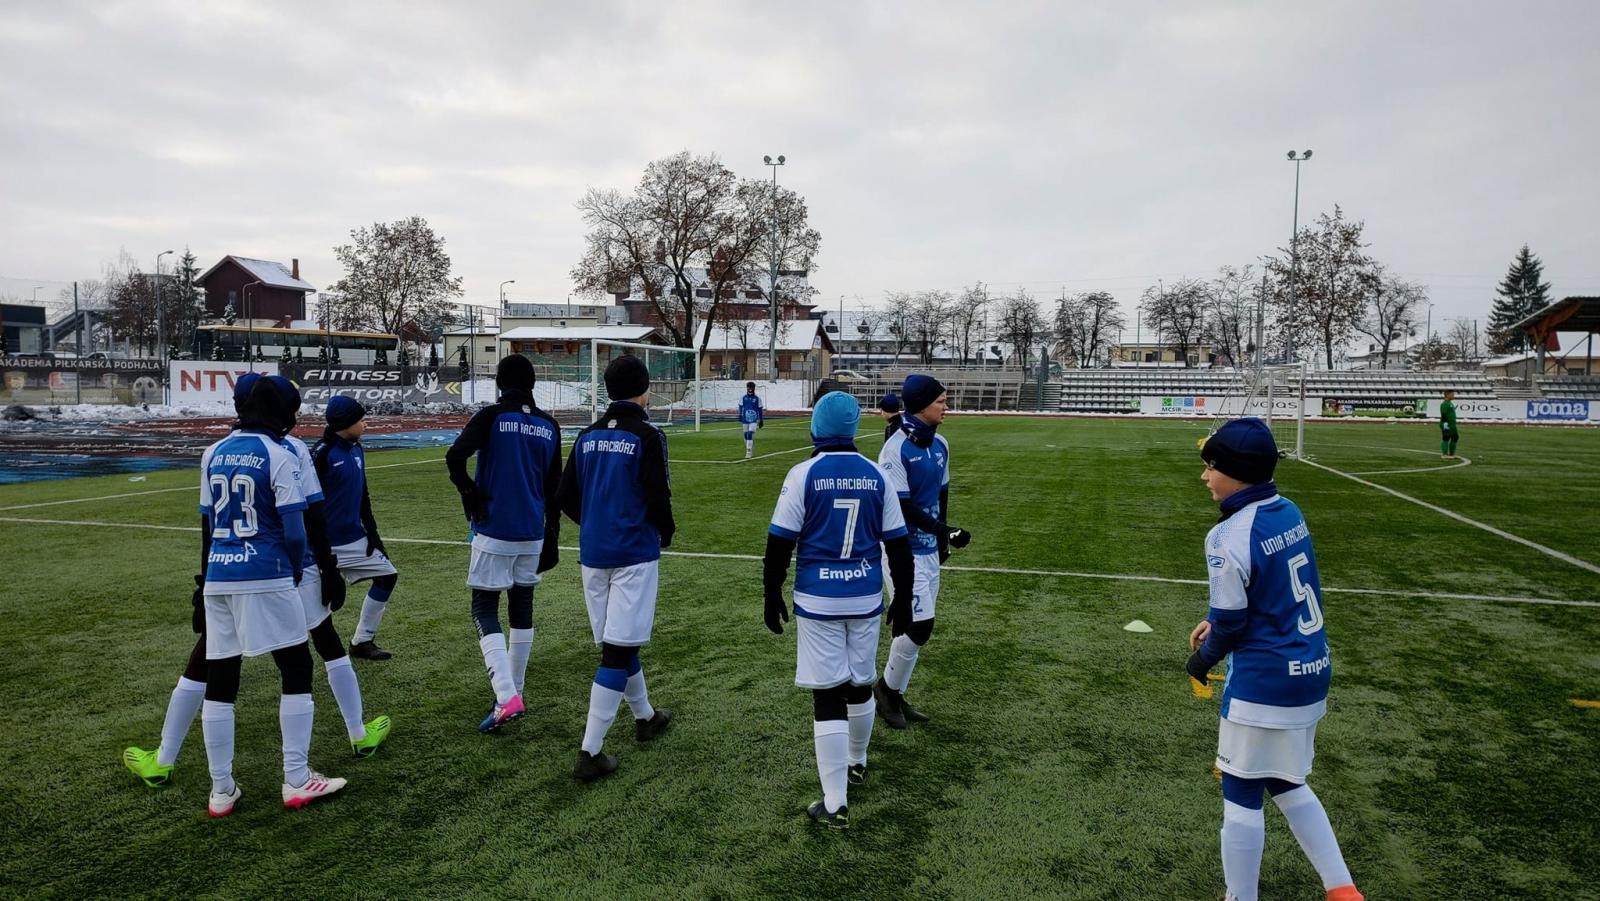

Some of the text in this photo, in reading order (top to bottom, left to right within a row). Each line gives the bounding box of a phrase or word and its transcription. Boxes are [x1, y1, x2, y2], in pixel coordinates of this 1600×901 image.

[0, 359, 160, 370] AKADEMIA PIŁKARSKA PODHALA
[303, 369, 401, 381] FITNESS
[209, 474, 259, 538] 23
[833, 498, 860, 559] 7
[1287, 552, 1324, 636] 5
